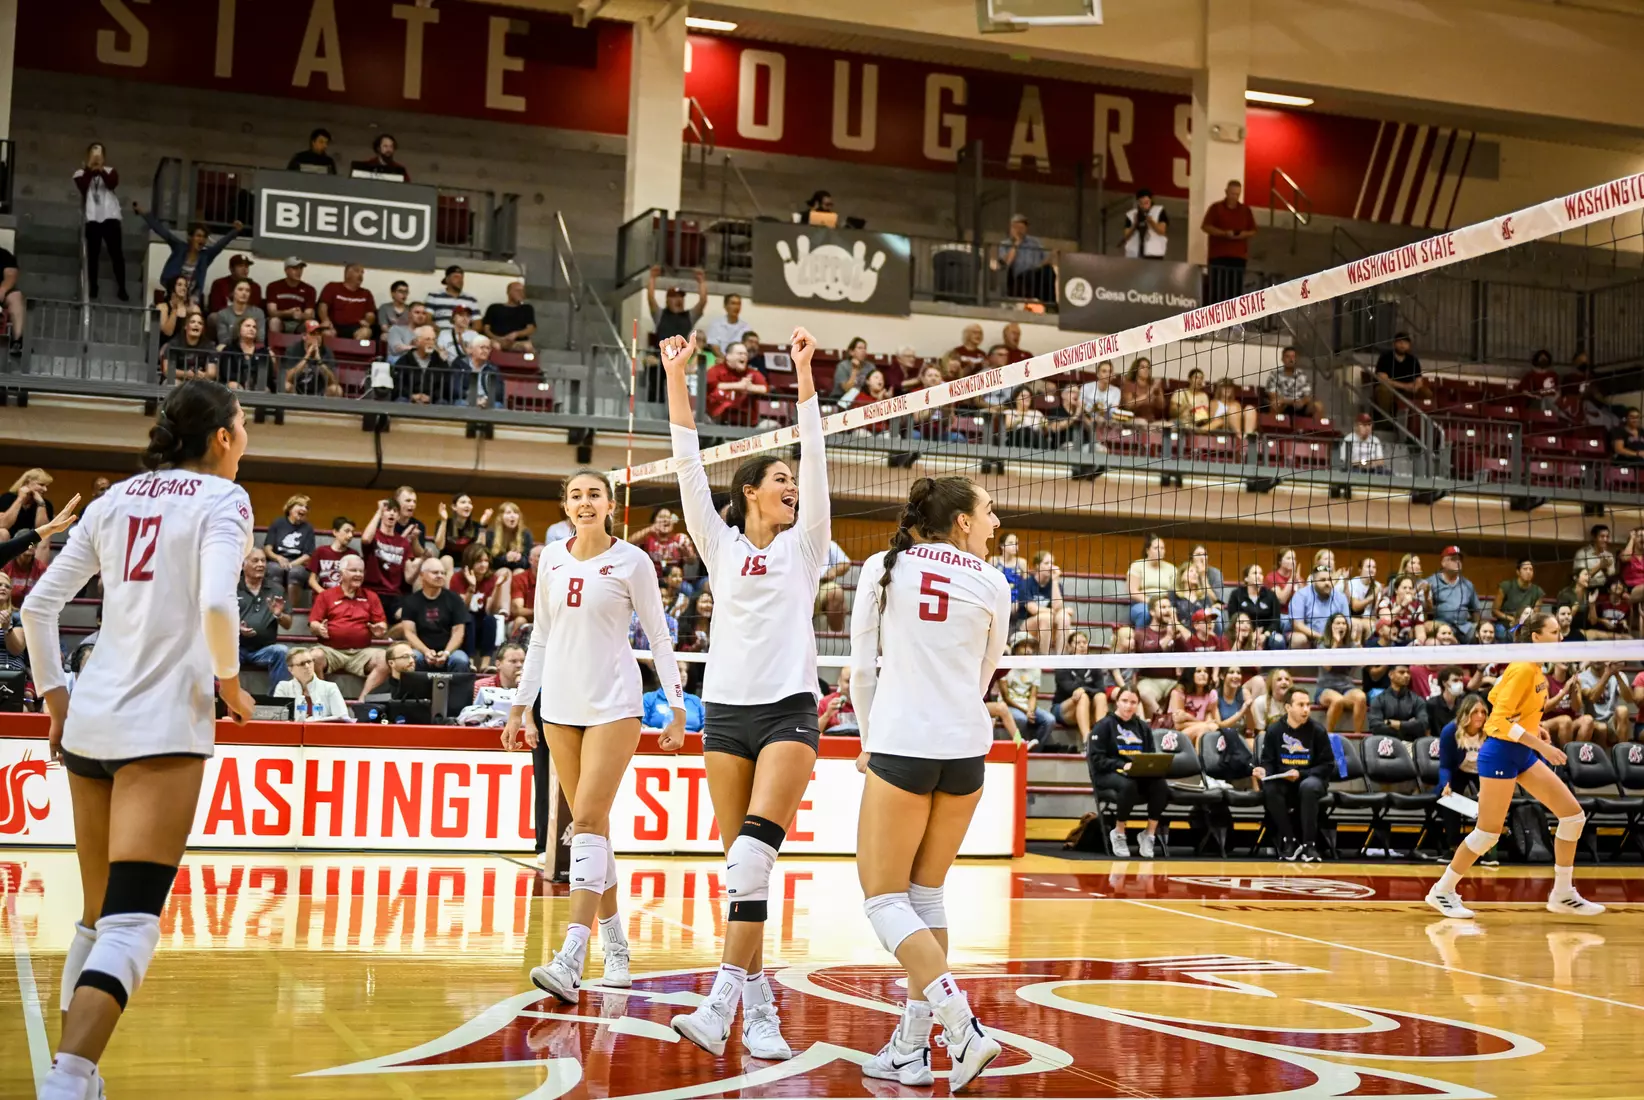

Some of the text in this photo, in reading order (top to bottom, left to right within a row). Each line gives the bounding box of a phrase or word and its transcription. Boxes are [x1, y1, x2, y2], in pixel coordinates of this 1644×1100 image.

[685, 40, 1193, 189] OUGAR
[1347, 233, 1456, 285] WASHINGTON STATE
[1095, 286, 1197, 309] Gesa Credit Union
[1183, 291, 1266, 332] WASHINGTON STATE
[1053, 334, 1120, 368] WASHINGTON STATE
[949, 374, 985, 398] WASHINGTON
[123, 514, 163, 582] 12
[905, 546, 982, 572] COUGARS
[567, 577, 584, 608] 8
[919, 571, 951, 622] 5
